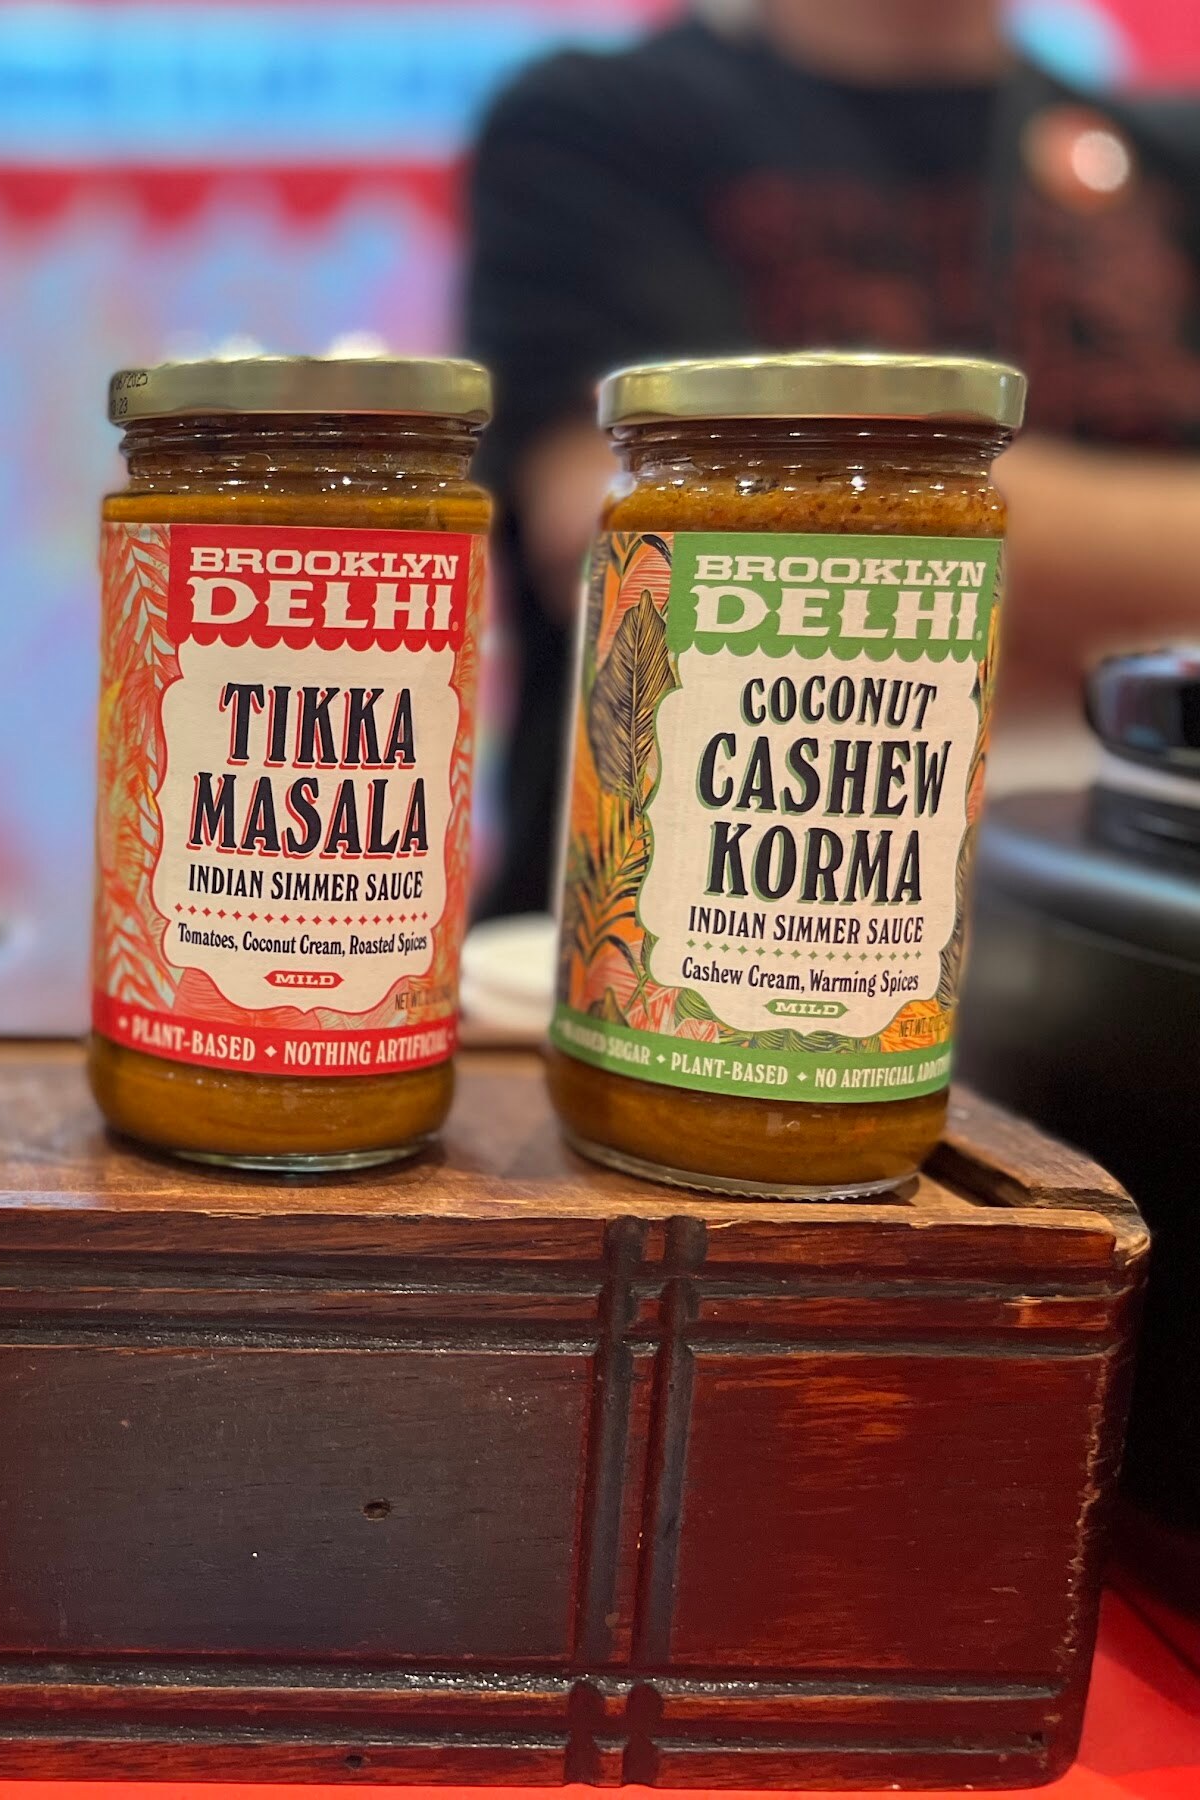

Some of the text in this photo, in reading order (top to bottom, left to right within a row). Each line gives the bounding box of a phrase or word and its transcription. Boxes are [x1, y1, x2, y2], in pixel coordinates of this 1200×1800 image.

[190, 547, 459, 579] BROOKLYN
[694, 555, 986, 587] BROOKLYN
[741, 674, 937, 731] COCONUT
[219, 683, 417, 770] TIKKA
[697, 732, 952, 818] CASHEW
[187, 772, 429, 859] MASALA
[188, 864, 424, 902] INDIAN SIMMER SAUCE
[704, 821, 922, 906] KORMA
[178, 922, 428, 958] Tomatoes, Coconut Cream, Roasted Spices
[688, 905, 924, 945] INDIAN SIMMER SAUCE
[274, 973, 335, 986] MILD
[681, 957, 919, 997] Cashew Cream, Warming Spices
[395, 992, 409, 1010] NET
[774, 1002, 840, 1015] MILD
[131, 1018, 255, 1062] PLANT-BASED
[284, 1040, 372, 1066] NOTHING
[899, 1019, 914, 1037] NET
[607, 1037, 651, 1065] SUGAR
[671, 1051, 789, 1085] PLANT-BASED
[814, 1067, 837, 1088] NO
[841, 1065, 914, 1088] ARTIFICIAL
